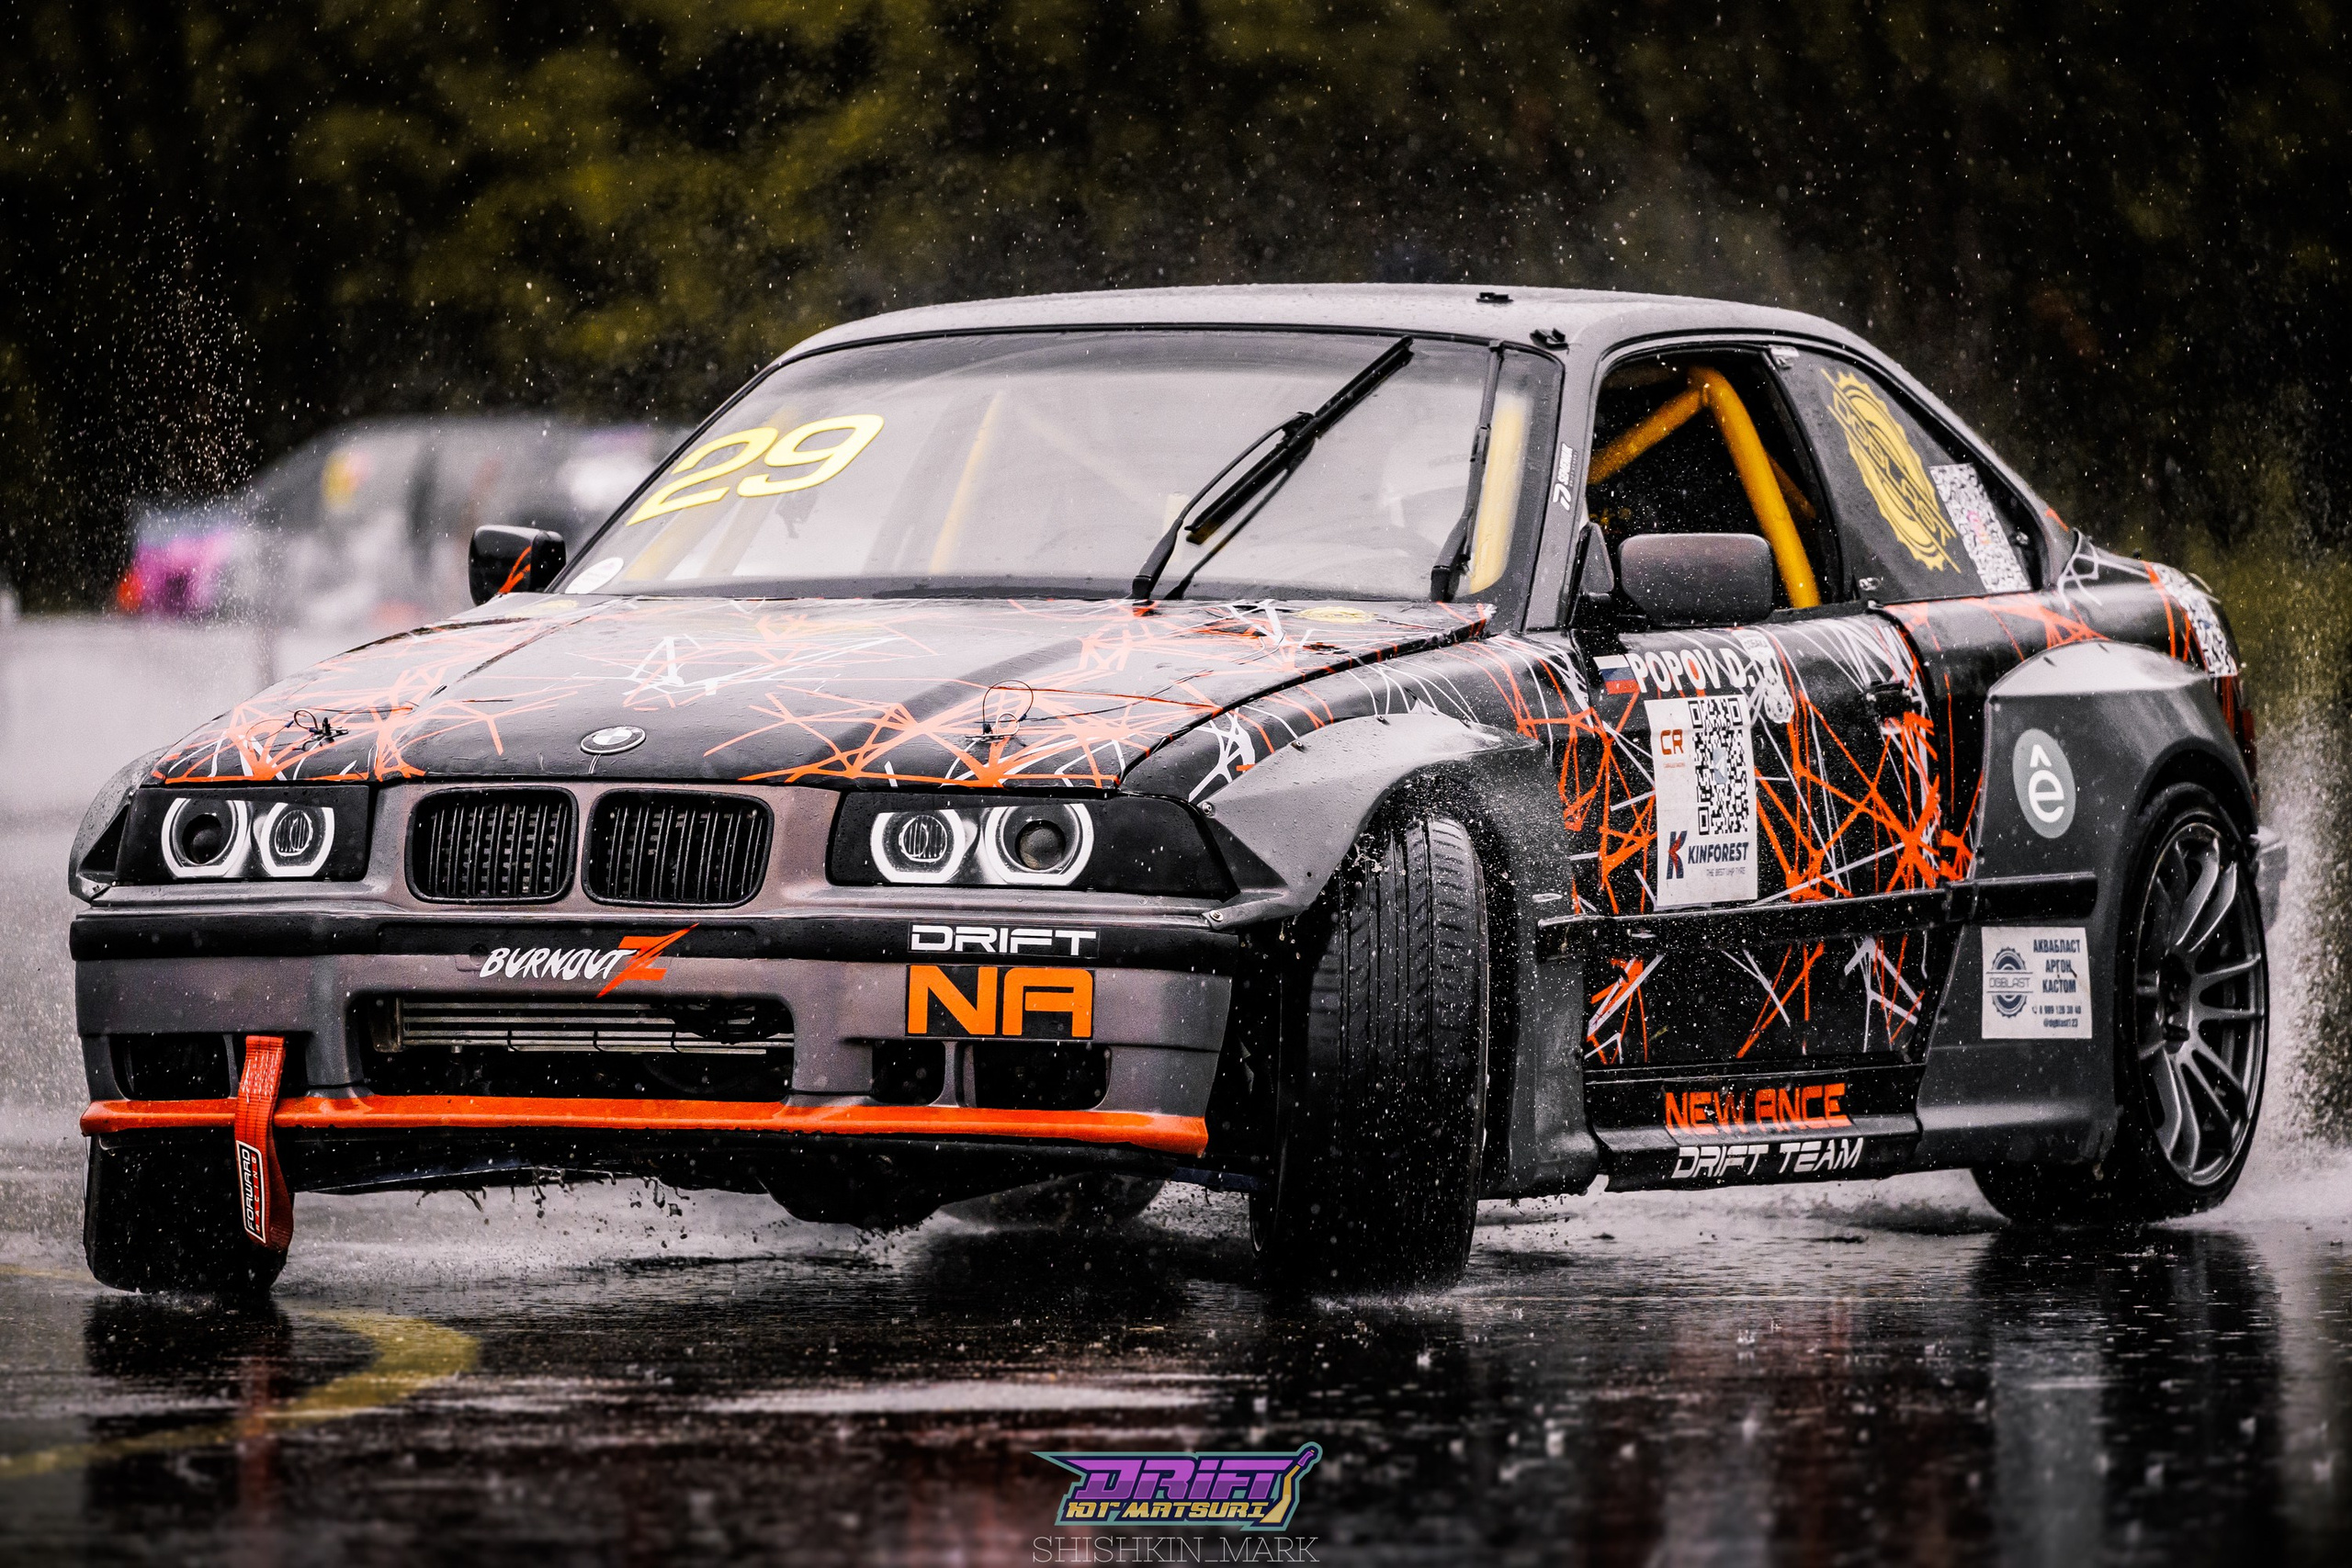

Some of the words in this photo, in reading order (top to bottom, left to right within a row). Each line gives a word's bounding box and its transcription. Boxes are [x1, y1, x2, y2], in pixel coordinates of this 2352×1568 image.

[626, 414, 885, 526] 29
[1625, 649, 1721, 694] POPOV
[1719, 648, 1757, 688] D.
[1660, 728, 1684, 755] CR
[1687, 841, 1749, 864] KINFOREST
[910, 924, 1097, 956] DRIFT
[2032, 939, 2080, 953] АКВАБЛАСТ
[2041, 979, 2076, 993] КАСТОМ
[2045, 959, 2072, 974] АРГОН
[907, 964, 1094, 1038] NA
[1664, 1091, 1748, 1135] NEW
[1670, 1144, 1770, 1179] DRIFT
[1778, 1137, 1865, 1174] TEAM
[241, 1147, 255, 1232] FORWARD
[251, 1155, 261, 1233] RACING
